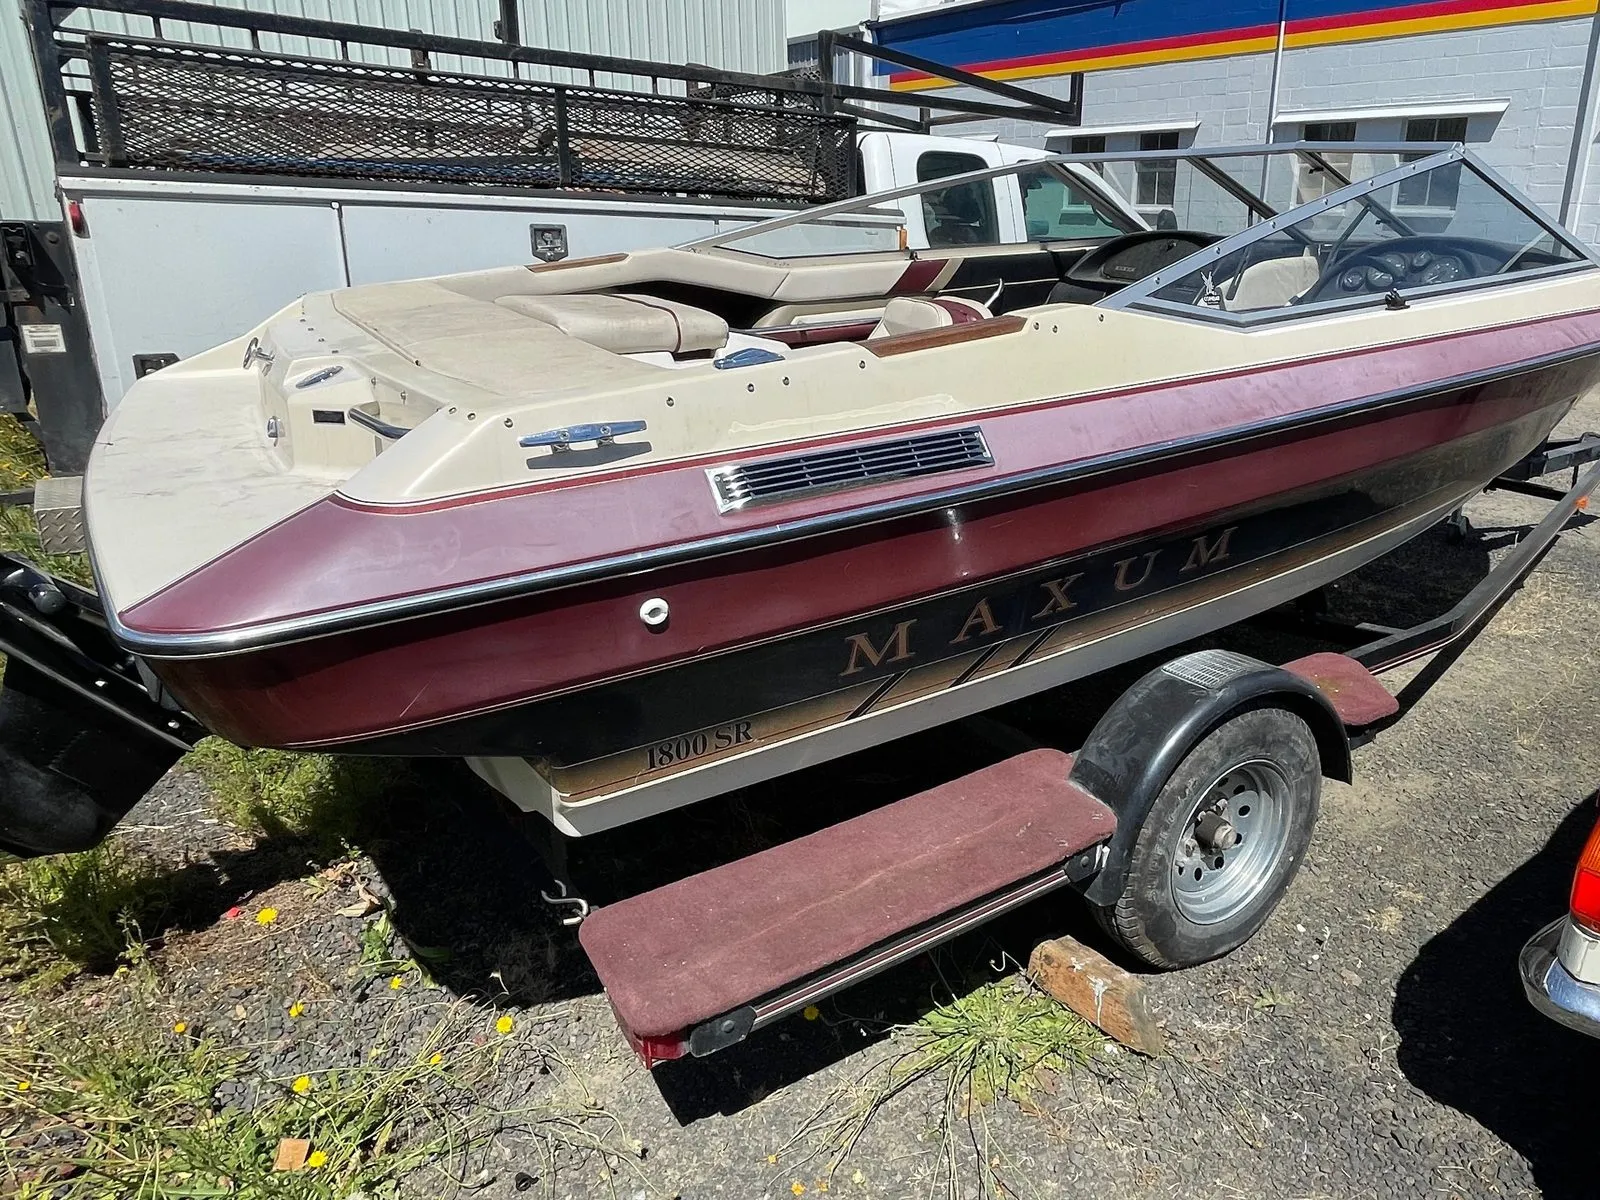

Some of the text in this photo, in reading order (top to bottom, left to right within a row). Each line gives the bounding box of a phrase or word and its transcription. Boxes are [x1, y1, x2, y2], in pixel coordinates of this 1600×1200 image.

[838, 526, 1239, 677] MAXUM
[647, 721, 753, 770] 1800 SR
